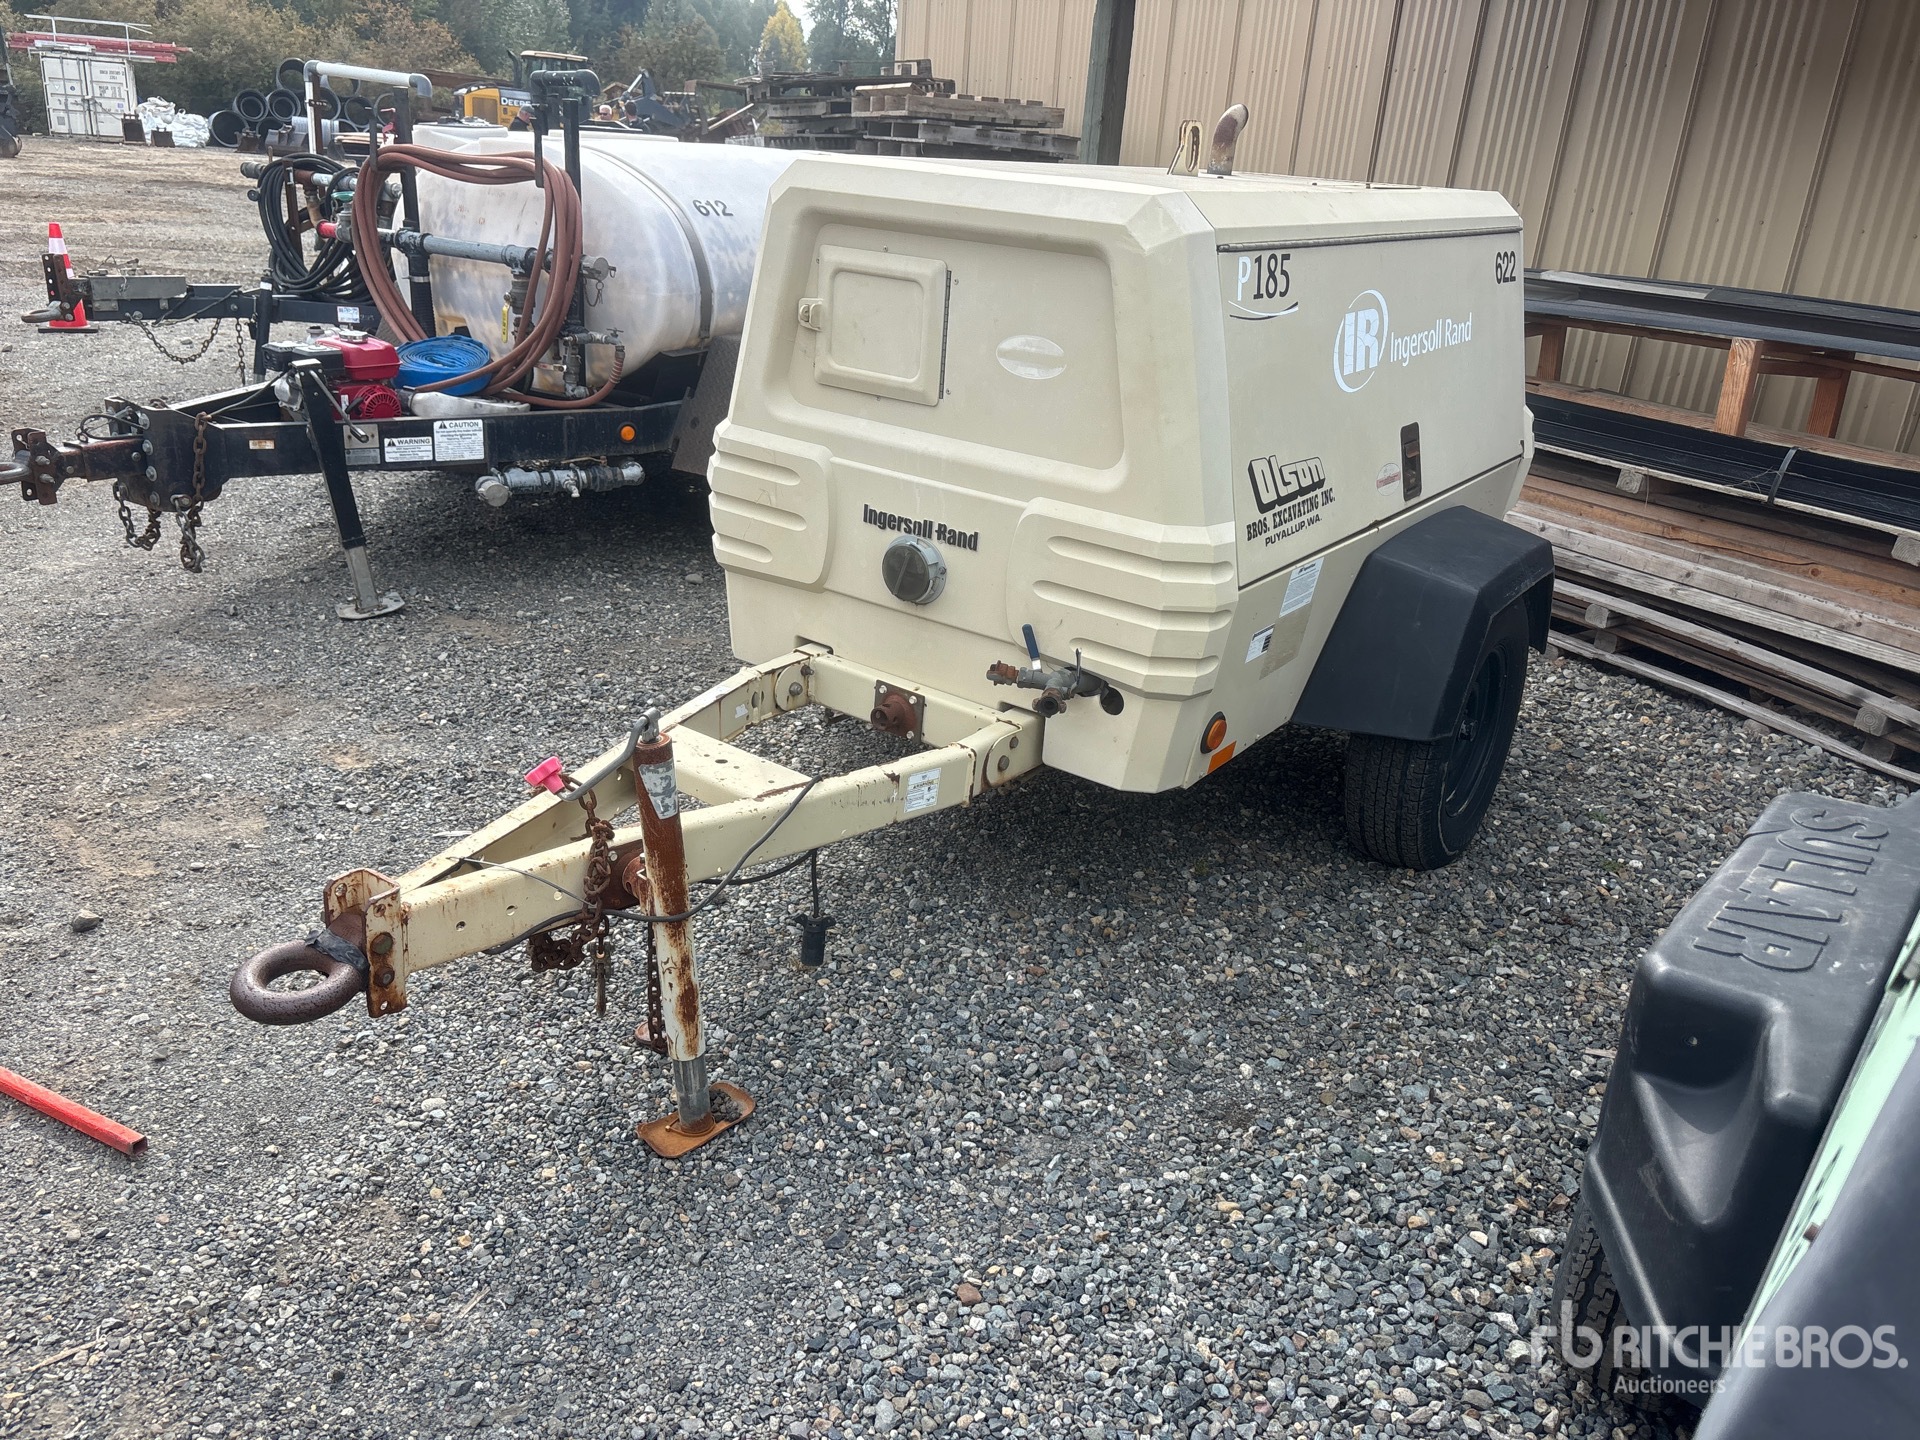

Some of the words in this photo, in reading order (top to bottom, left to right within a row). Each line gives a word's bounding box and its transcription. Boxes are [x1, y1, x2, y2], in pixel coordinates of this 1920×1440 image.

[693, 200, 734, 217] 612
[1495, 250, 1517, 284] 622
[1343, 308, 1380, 376] IR
[1390, 319, 1442, 367] Ingersoll
[1444, 311, 1472, 347] Rand
[1246, 516, 1271, 542] BROS.
[1272, 493, 1320, 530] EXCAVATING
[1320, 487, 1336, 507] INC.
[1692, 808, 1890, 973] SULLAIR
